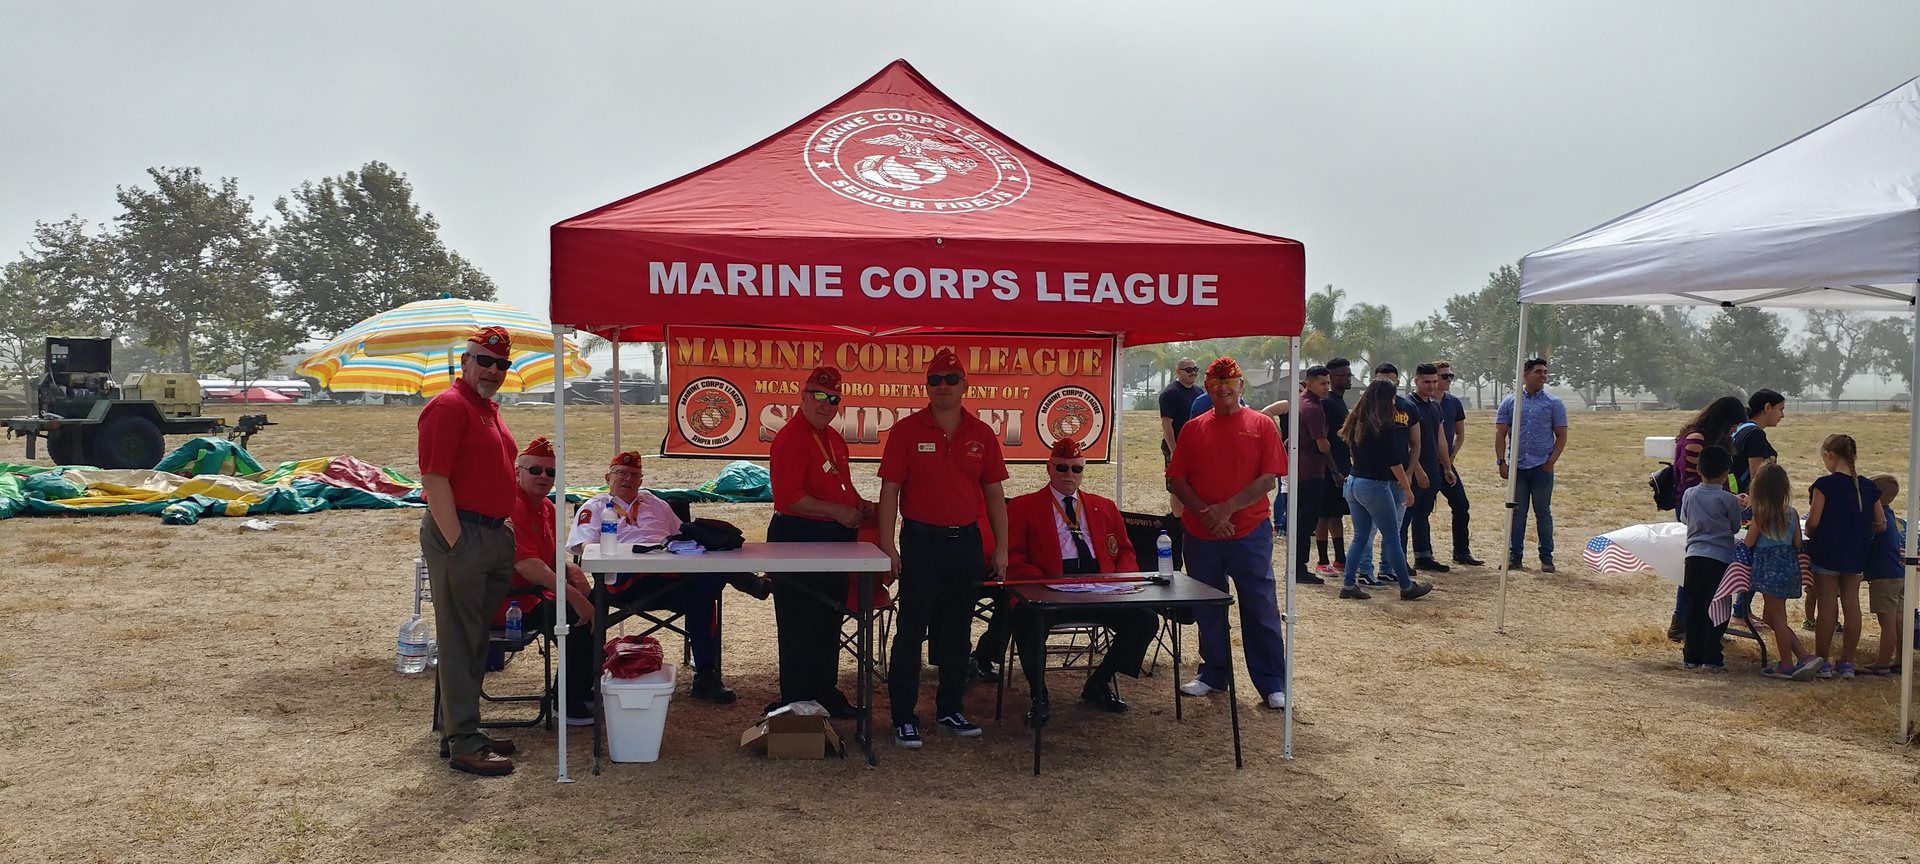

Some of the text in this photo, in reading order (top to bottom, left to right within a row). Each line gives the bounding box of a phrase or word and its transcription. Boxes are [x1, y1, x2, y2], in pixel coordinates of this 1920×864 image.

[815, 112, 1017, 172] MARINE CORPS LEAGUE
[831, 178, 1013, 210] SEMPER FIDELIS
[649, 261, 1218, 306] MARINE CORPS LEAGUE
[675, 337, 824, 370] MARINE
[968, 346, 1102, 376] LEAGUE
[681, 381, 743, 407] MARINE CORPS LEAGUE
[754, 380, 800, 395] MCAS
[1002, 385, 1030, 400] 017
[1041, 390, 1101, 415] MARINE CORPS LEAGUE
